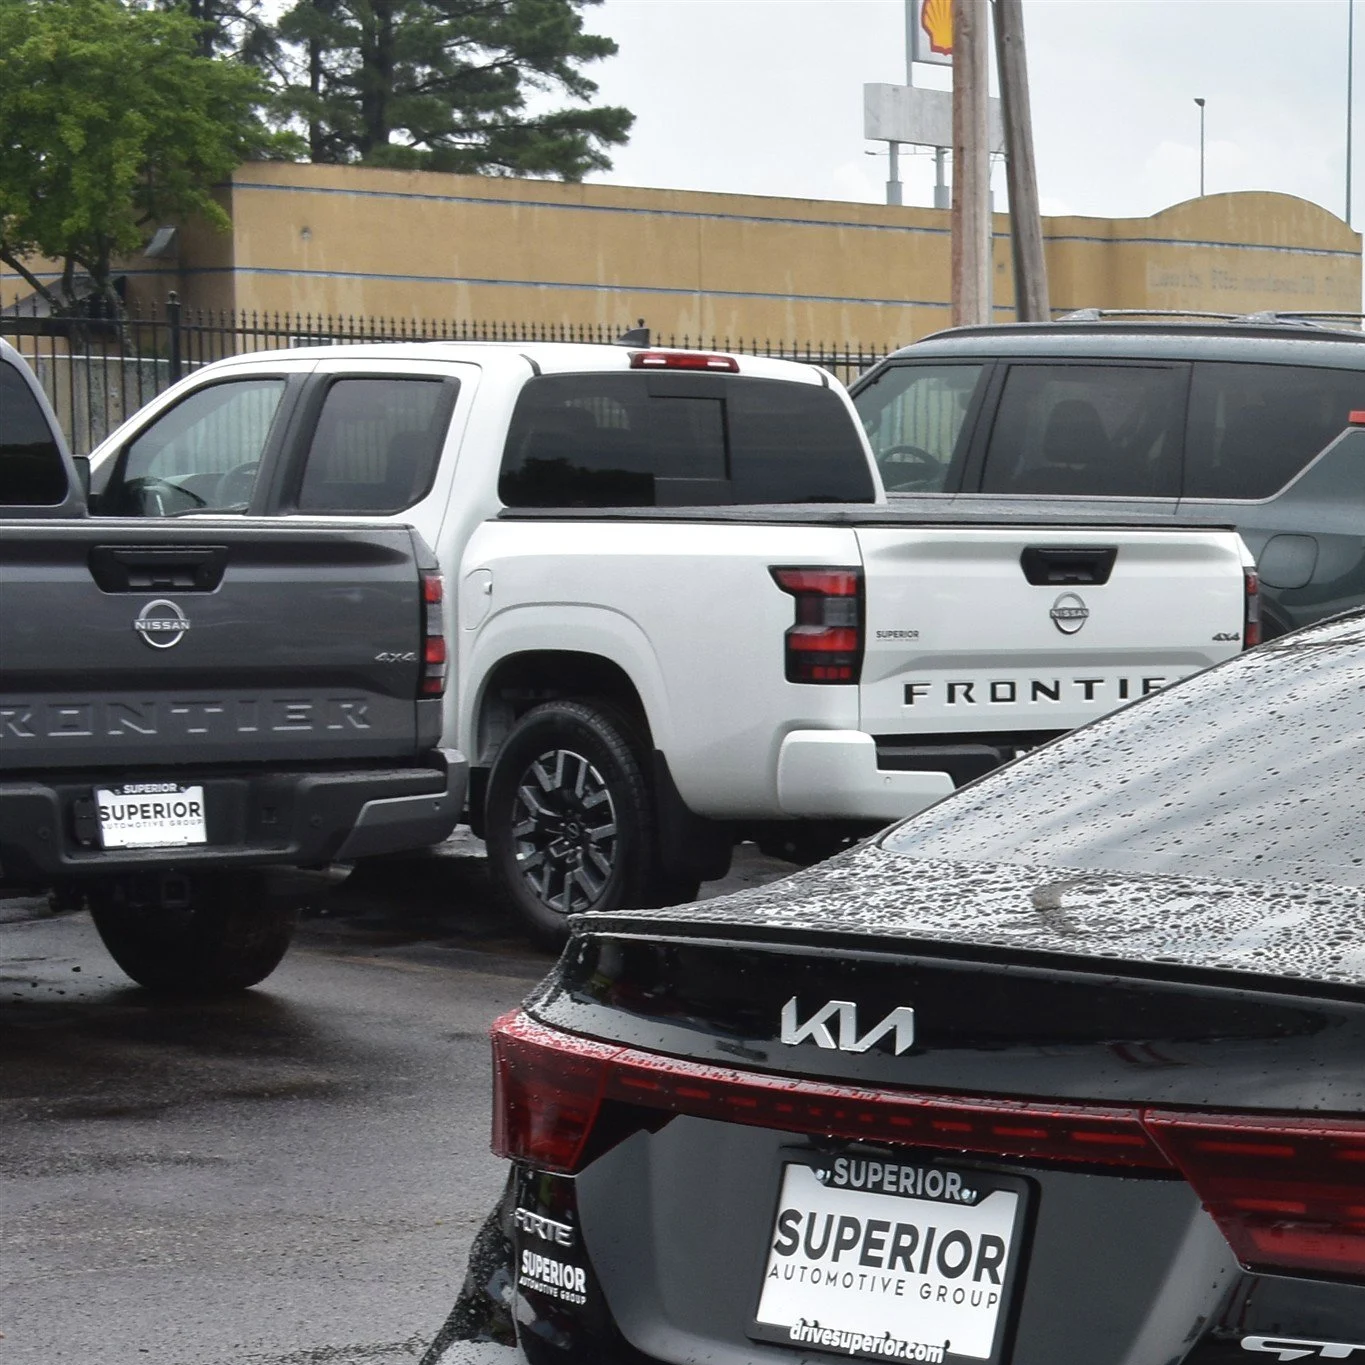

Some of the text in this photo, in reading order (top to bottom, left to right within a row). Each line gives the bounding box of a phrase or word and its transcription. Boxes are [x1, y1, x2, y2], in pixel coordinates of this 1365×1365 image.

[135, 621, 190, 630] NISSAN
[875, 630, 919, 639] SUPERIOR
[903, 677, 1184, 705] FRONTIE
[0, 697, 371, 738] RONTIER
[123, 783, 178, 794] SUPERIOR
[100, 801, 202, 821] SUPERIOR
[780, 995, 915, 1056] KIA
[833, 1157, 963, 1201] SUPERIOR
[773, 1208, 1006, 1286] SUPERIOR
[522, 1249, 586, 1293] SUPERIOR
[768, 1263, 999, 1310] AUTOMOTIVE GROUP
[560, 1291, 586, 1304] GROUP
[789, 1319, 944, 1364] drivesuperior.com
